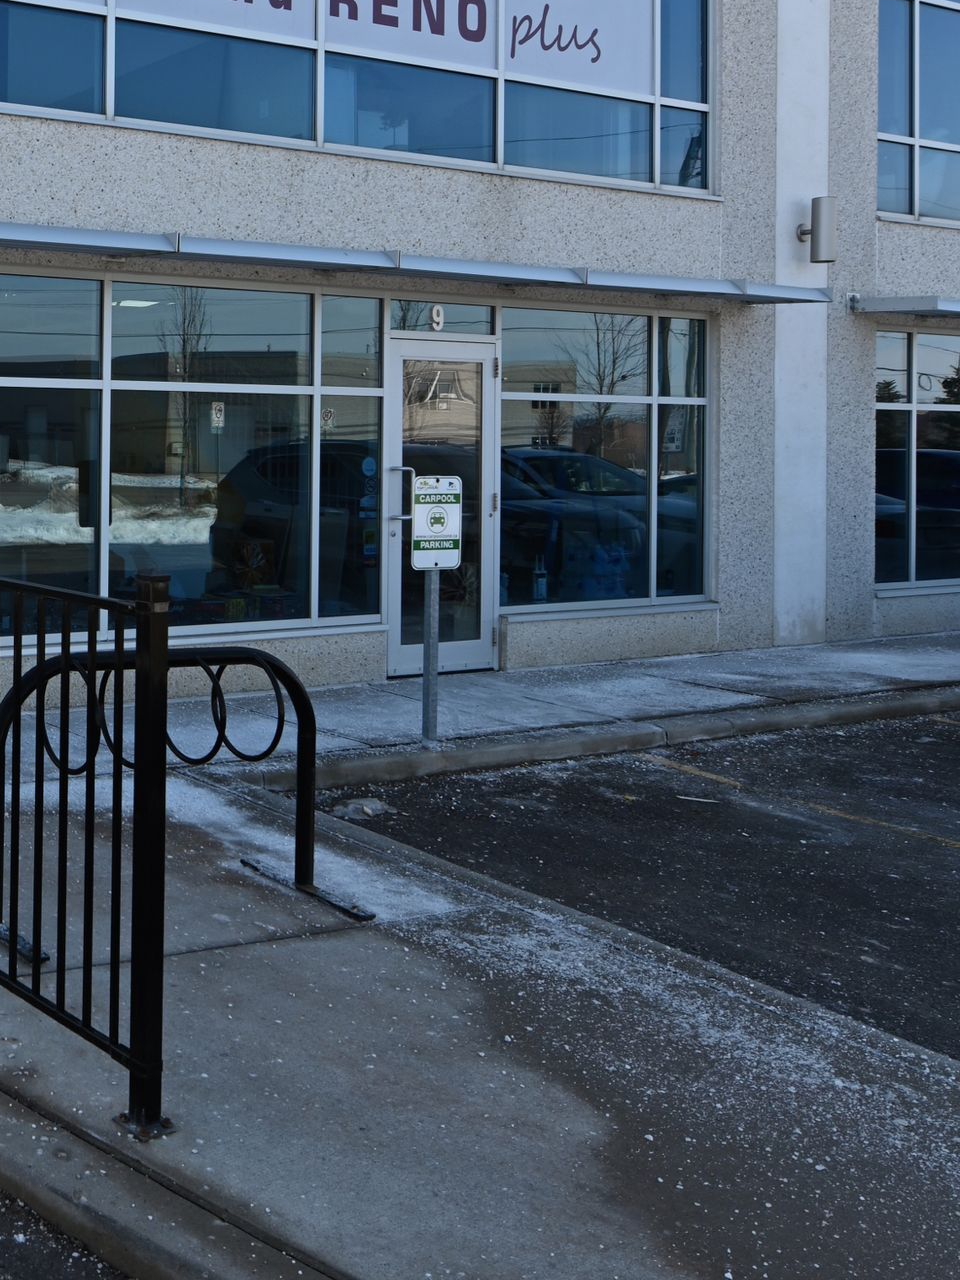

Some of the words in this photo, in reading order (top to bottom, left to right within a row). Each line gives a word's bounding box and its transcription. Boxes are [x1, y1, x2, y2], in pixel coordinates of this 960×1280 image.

[510, 3, 602, 64] plus
[432, 304, 444, 331] 9
[420, 495, 456, 503] CARPOOL
[420, 540, 454, 549] PARKING
